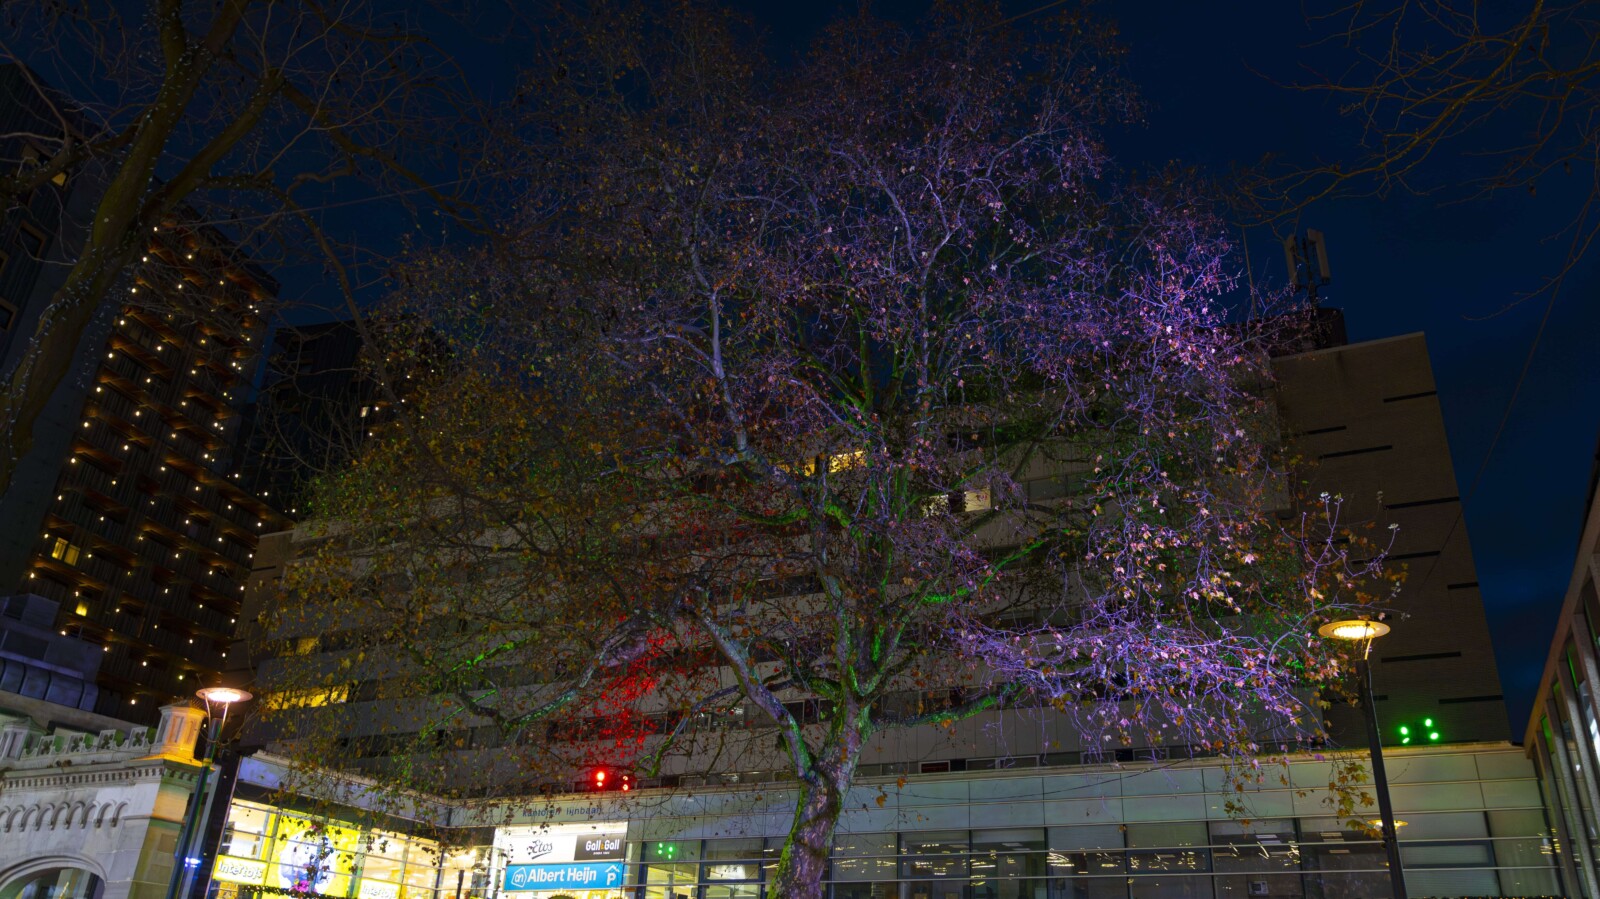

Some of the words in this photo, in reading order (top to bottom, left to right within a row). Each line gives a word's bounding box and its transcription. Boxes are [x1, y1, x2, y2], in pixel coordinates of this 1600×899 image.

[566, 806, 602, 816] lijnbaan
[531, 839, 553, 854] Etos
[527, 868, 565, 883] Albert
[567, 867, 596, 884] Heijn
